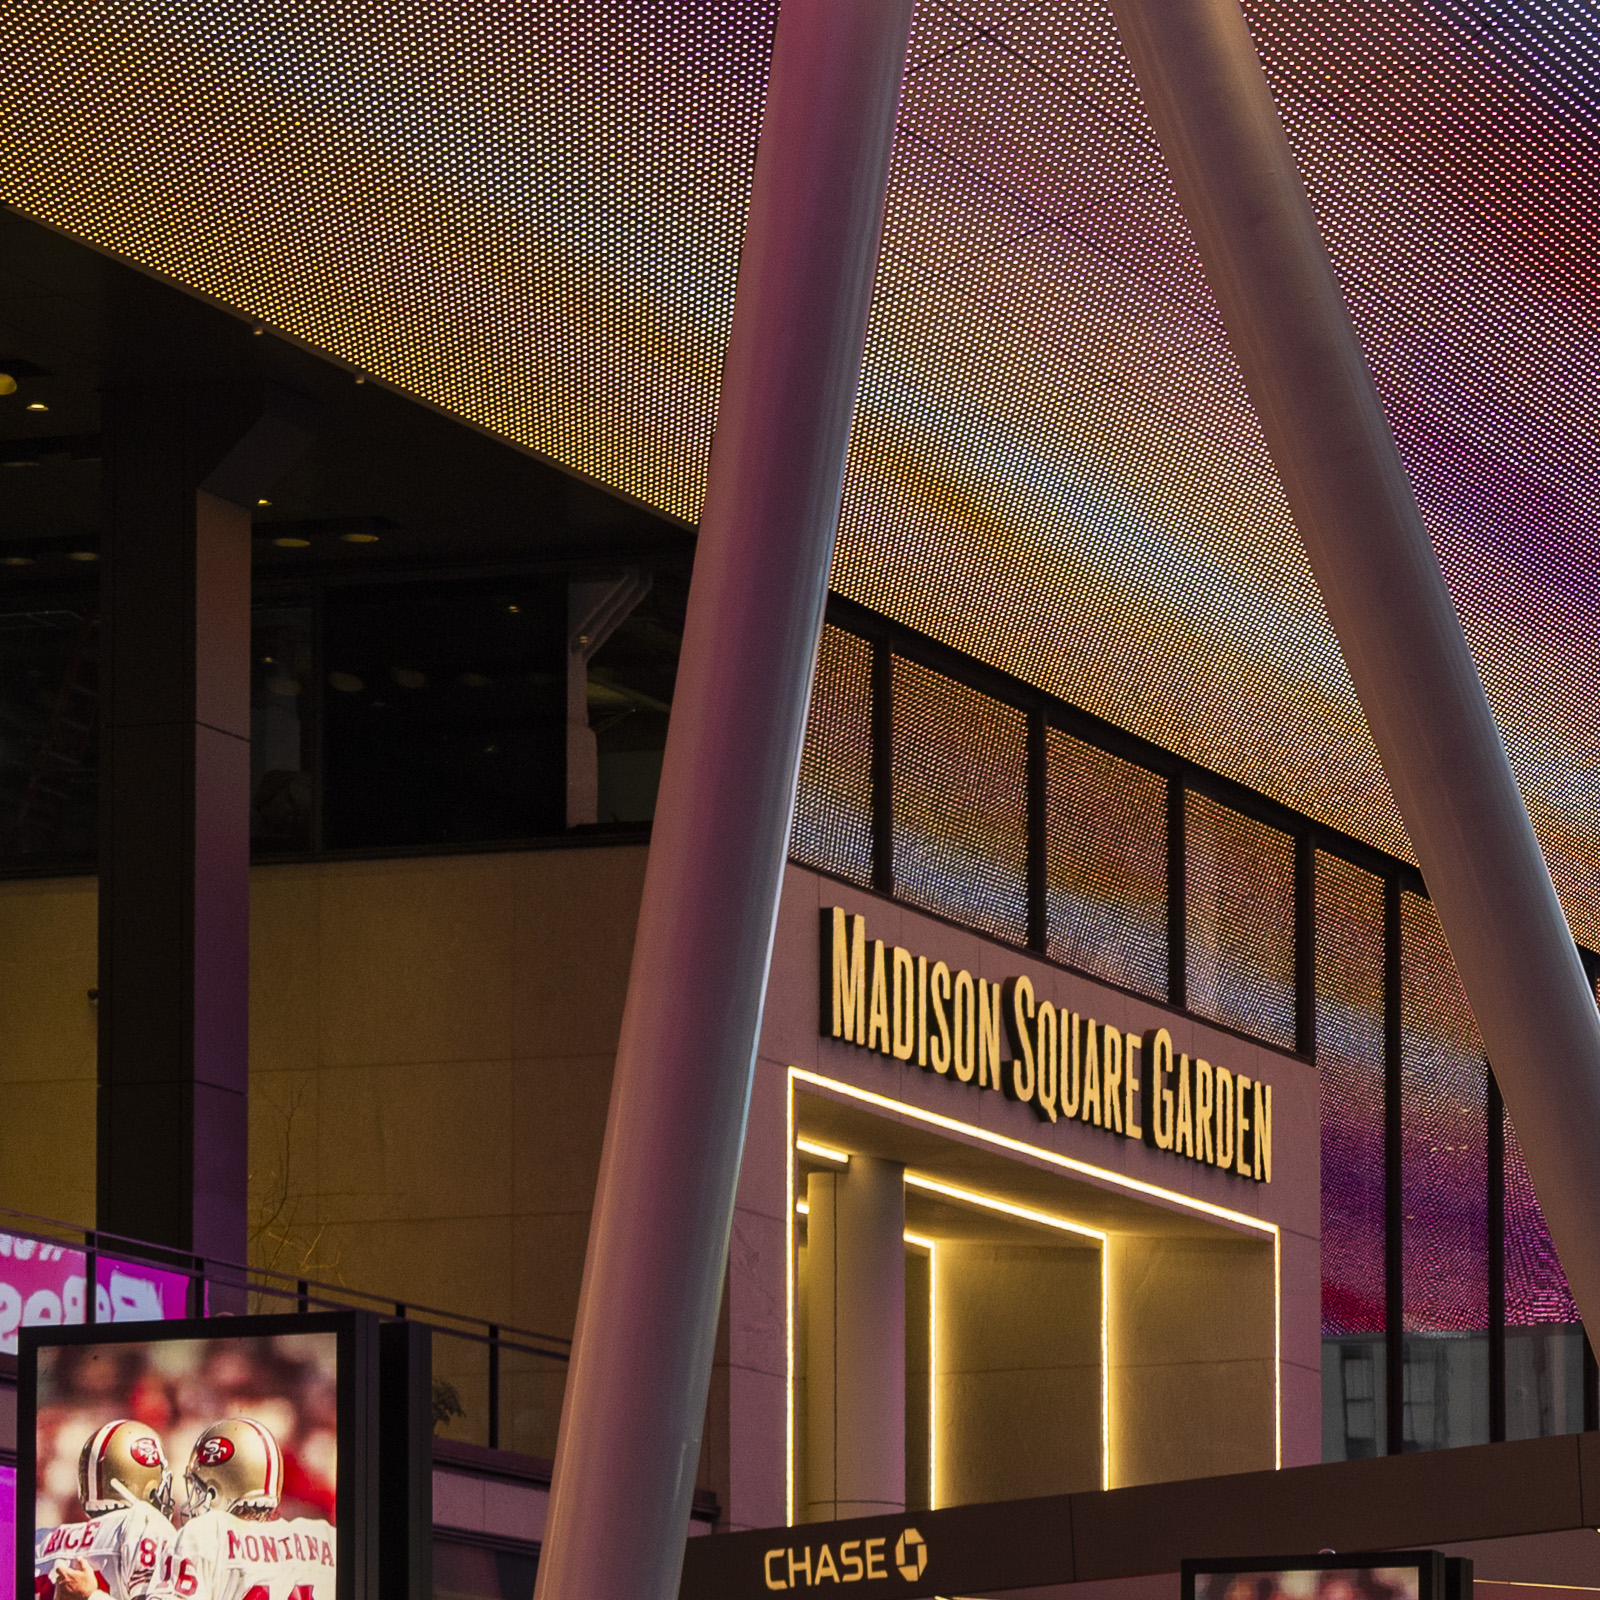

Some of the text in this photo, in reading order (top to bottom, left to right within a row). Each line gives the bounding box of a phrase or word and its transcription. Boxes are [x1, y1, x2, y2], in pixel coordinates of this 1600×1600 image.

[830, 906, 1273, 1183] MADISON SQUARE GARDEN
[44, 1522, 101, 1555] RICE
[227, 1530, 335, 1567] MONTANA
[765, 1537, 888, 1590] CHASE
